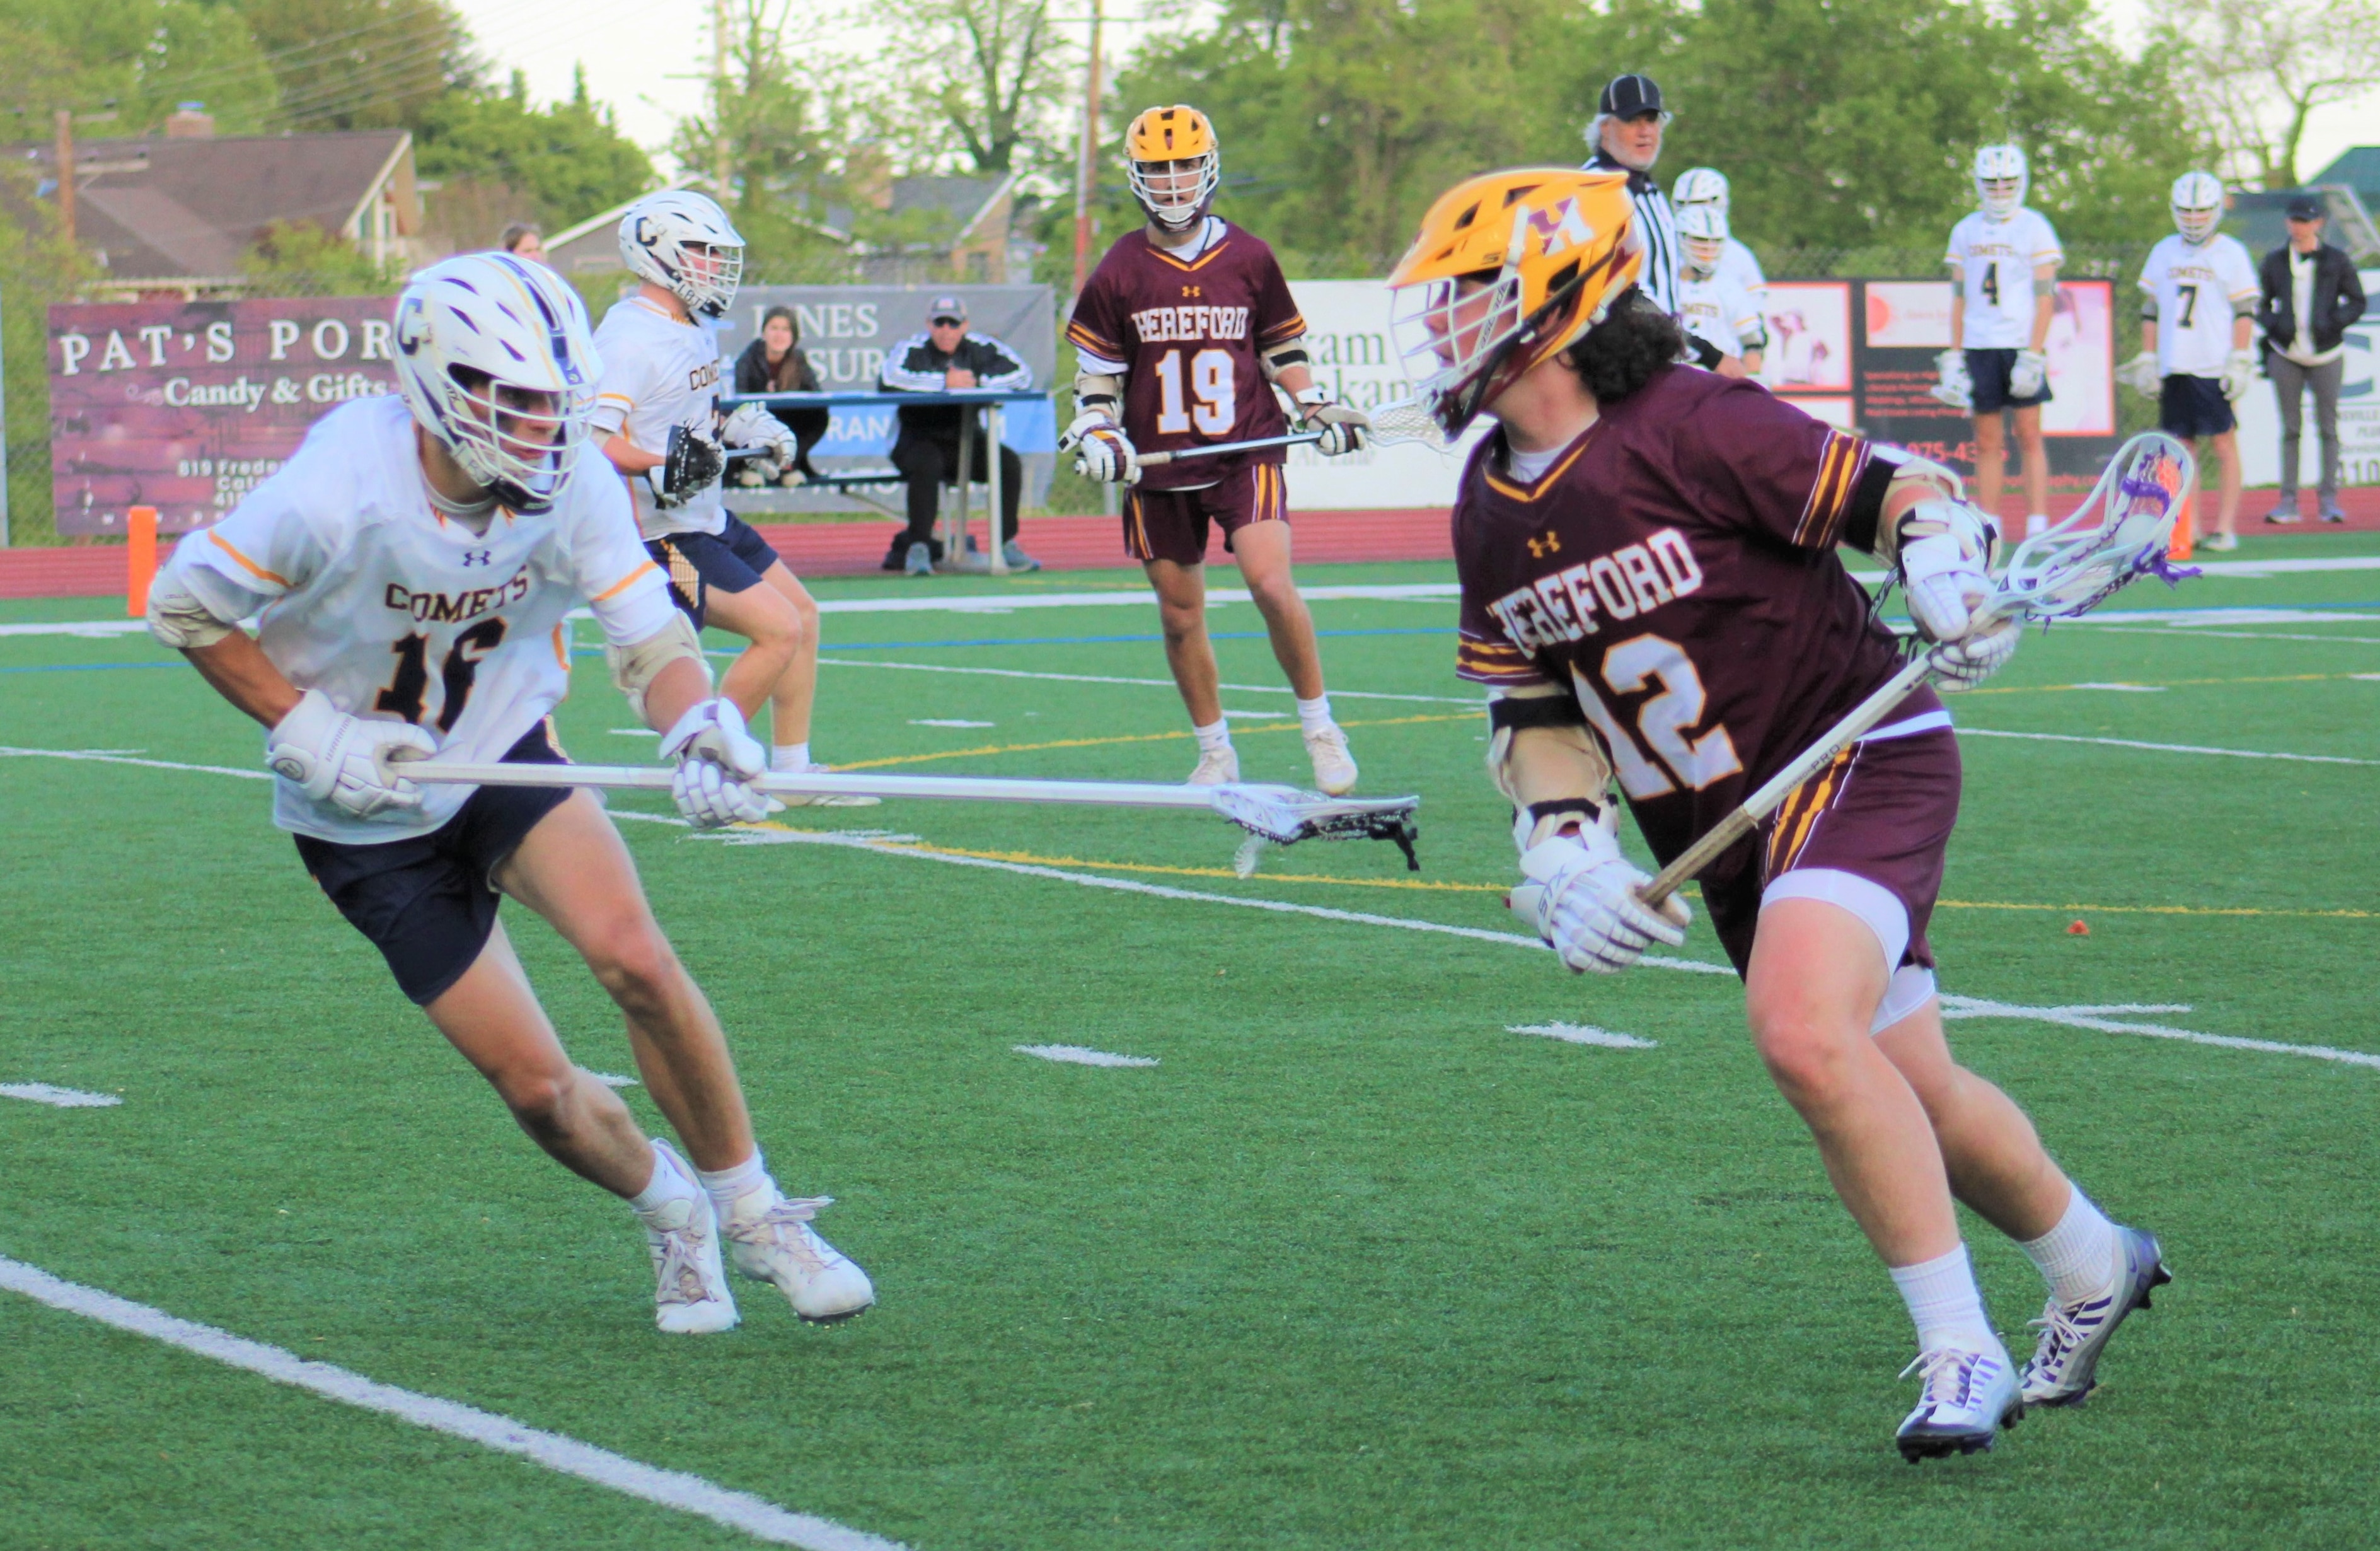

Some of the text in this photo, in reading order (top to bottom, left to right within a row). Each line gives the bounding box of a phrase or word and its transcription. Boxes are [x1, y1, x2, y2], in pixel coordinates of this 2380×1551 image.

[1982, 261, 2000, 306] 4
[2177, 283, 2198, 328] 7
[59, 317, 395, 376] PAT'S POR
[1131, 305, 1249, 343] HEREFORD
[163, 371, 389, 414] Candy & Gifts
[1155, 348, 1237, 436] 19
[216, 458, 289, 475] Frede
[384, 564, 529, 624] COMETS
[1568, 632, 1744, 801] 12
